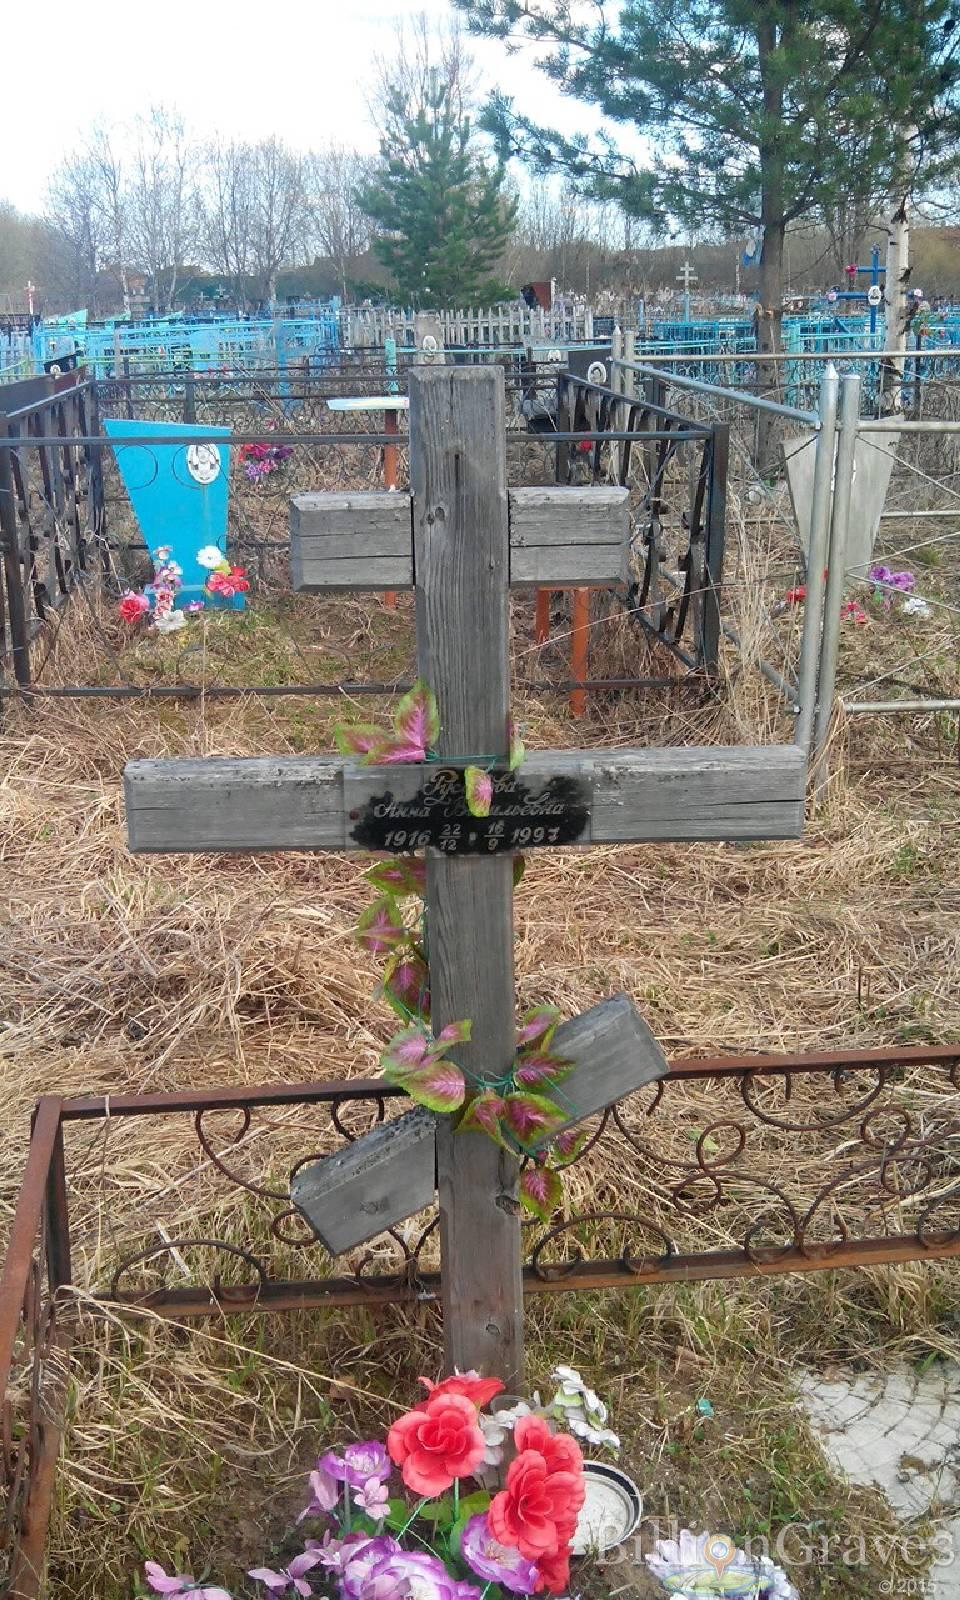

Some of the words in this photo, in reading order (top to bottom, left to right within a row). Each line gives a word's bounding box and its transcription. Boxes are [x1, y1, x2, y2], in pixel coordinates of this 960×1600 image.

[373, 800, 432, 818] Анна
[442, 823, 462, 836] 22
[384, 829, 432, 847] 1916
[440, 839, 457, 851] 12
